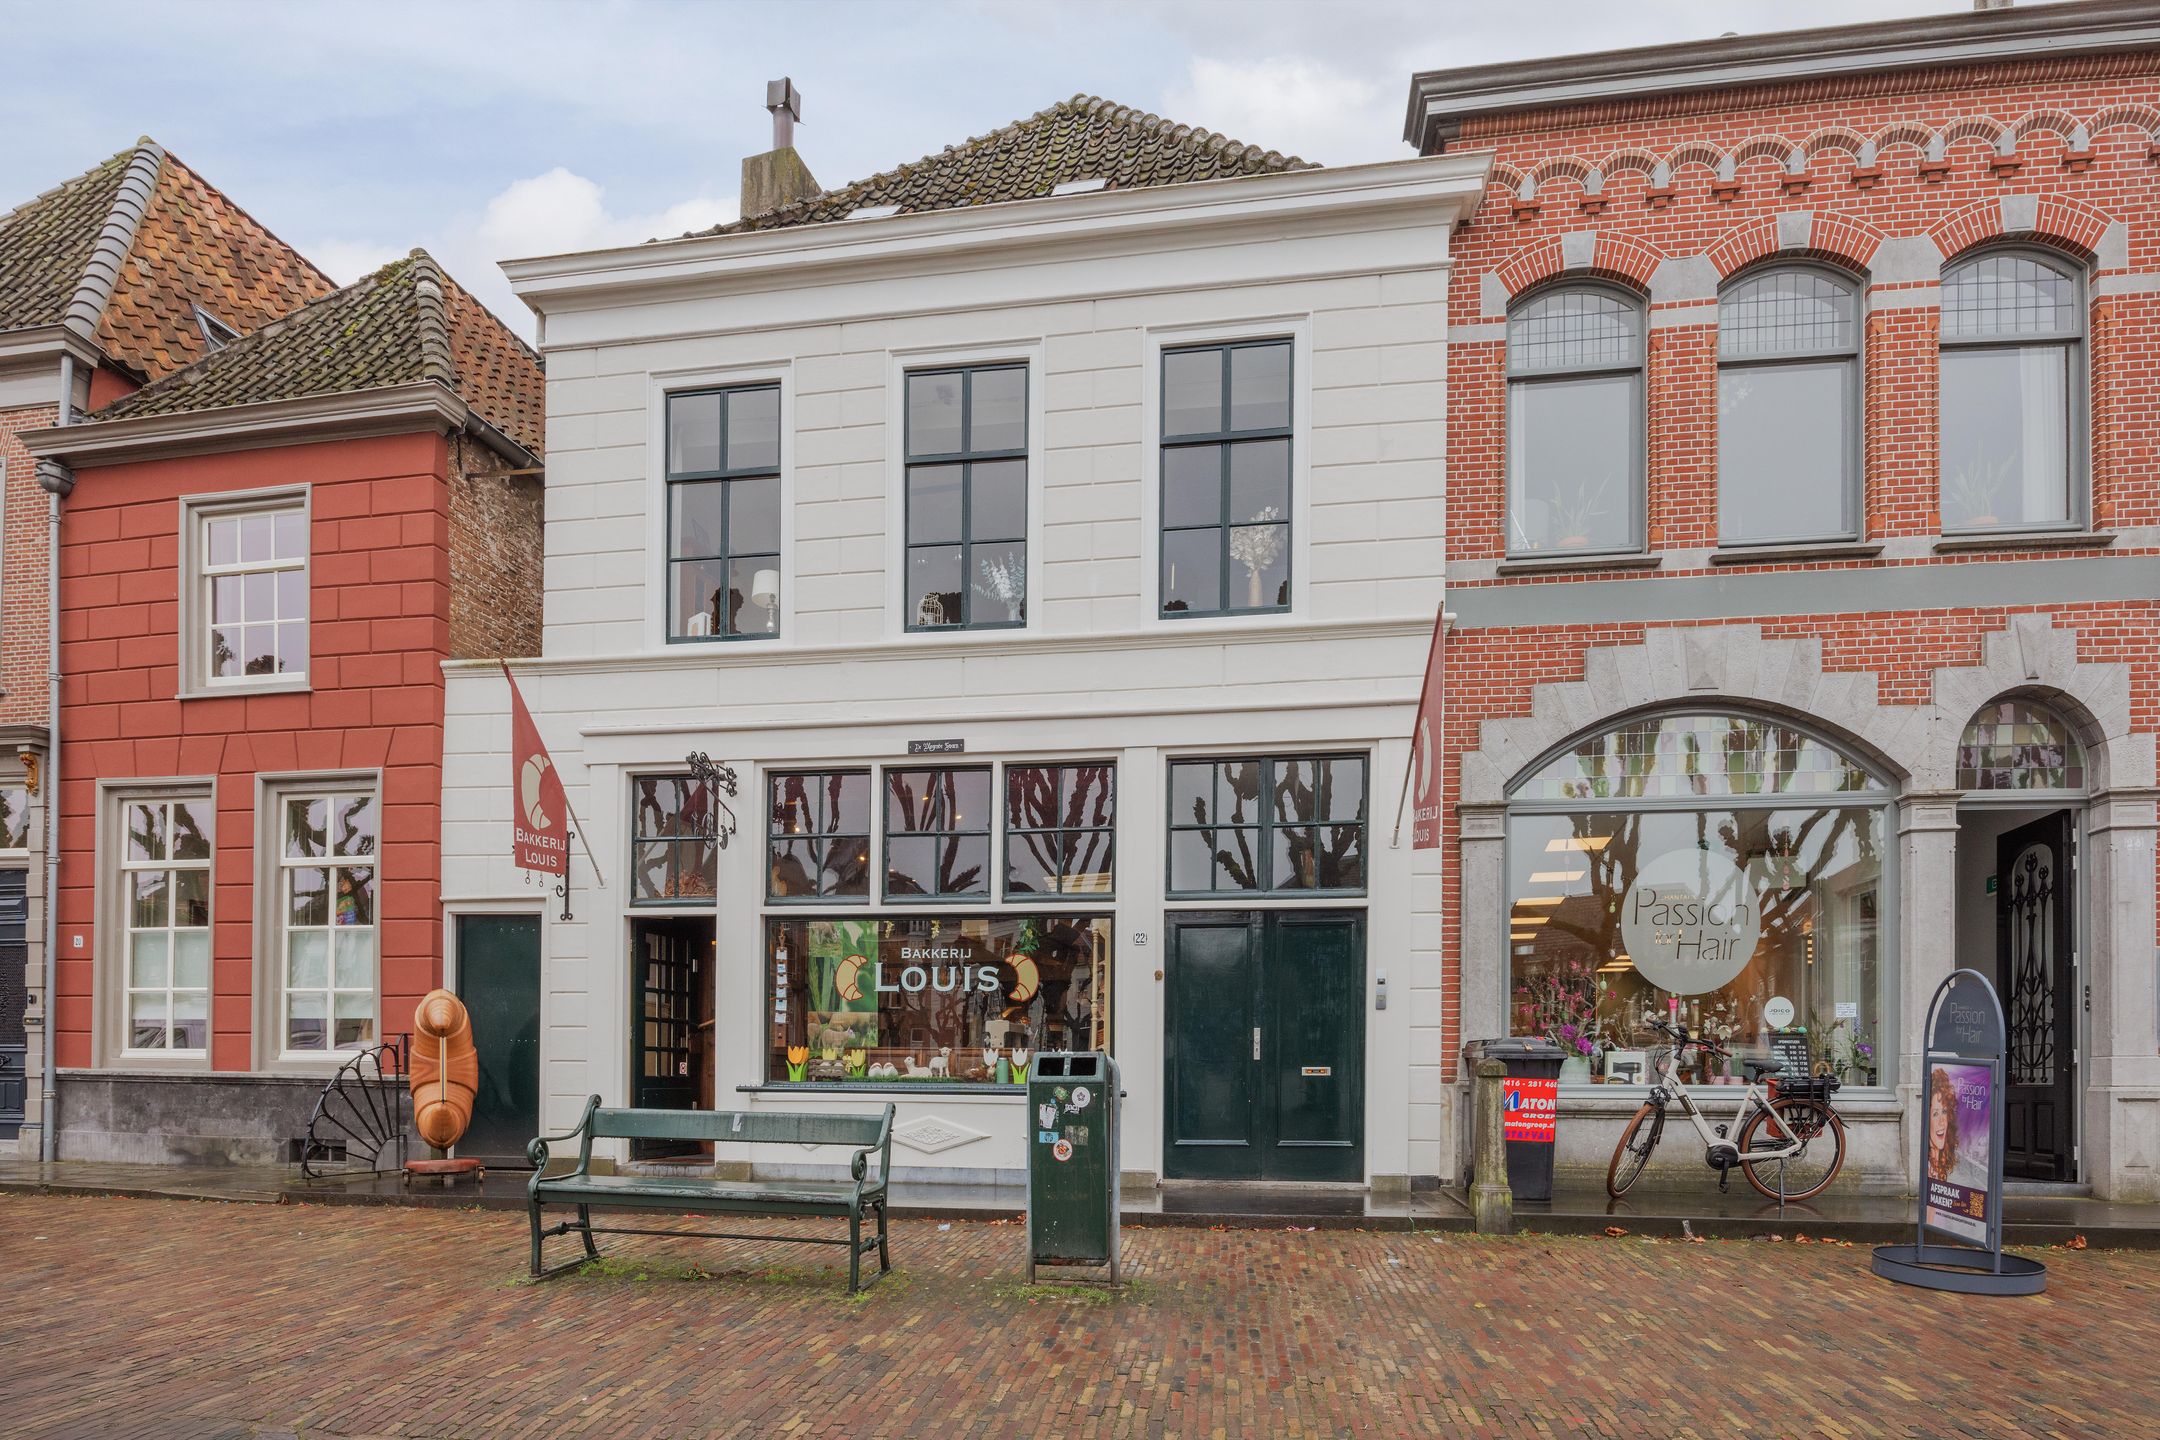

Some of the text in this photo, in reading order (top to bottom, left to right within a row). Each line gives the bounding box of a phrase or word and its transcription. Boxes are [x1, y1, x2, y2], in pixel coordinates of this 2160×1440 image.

[515, 827, 566, 851] BAKKERIJ
[525, 848, 557, 867] LOUIS
[1633, 888, 1750, 926] Passion
[1135, 932, 1145, 944] 22
[1655, 929, 1741, 960] for Hair
[901, 947, 972, 959] BAKKERIJ
[874, 962, 1000, 992] LOUIS
[1950, 1002, 1985, 1025] Passion
[1961, 1025, 1983, 1045] Hair
[1957, 1077, 1986, 1097] Passion
[1966, 1095, 1984, 1111] Hair
[1930, 1182, 1960, 1199] AFSPRAAK
[1930, 1193, 1953, 1209] MAKEN?
